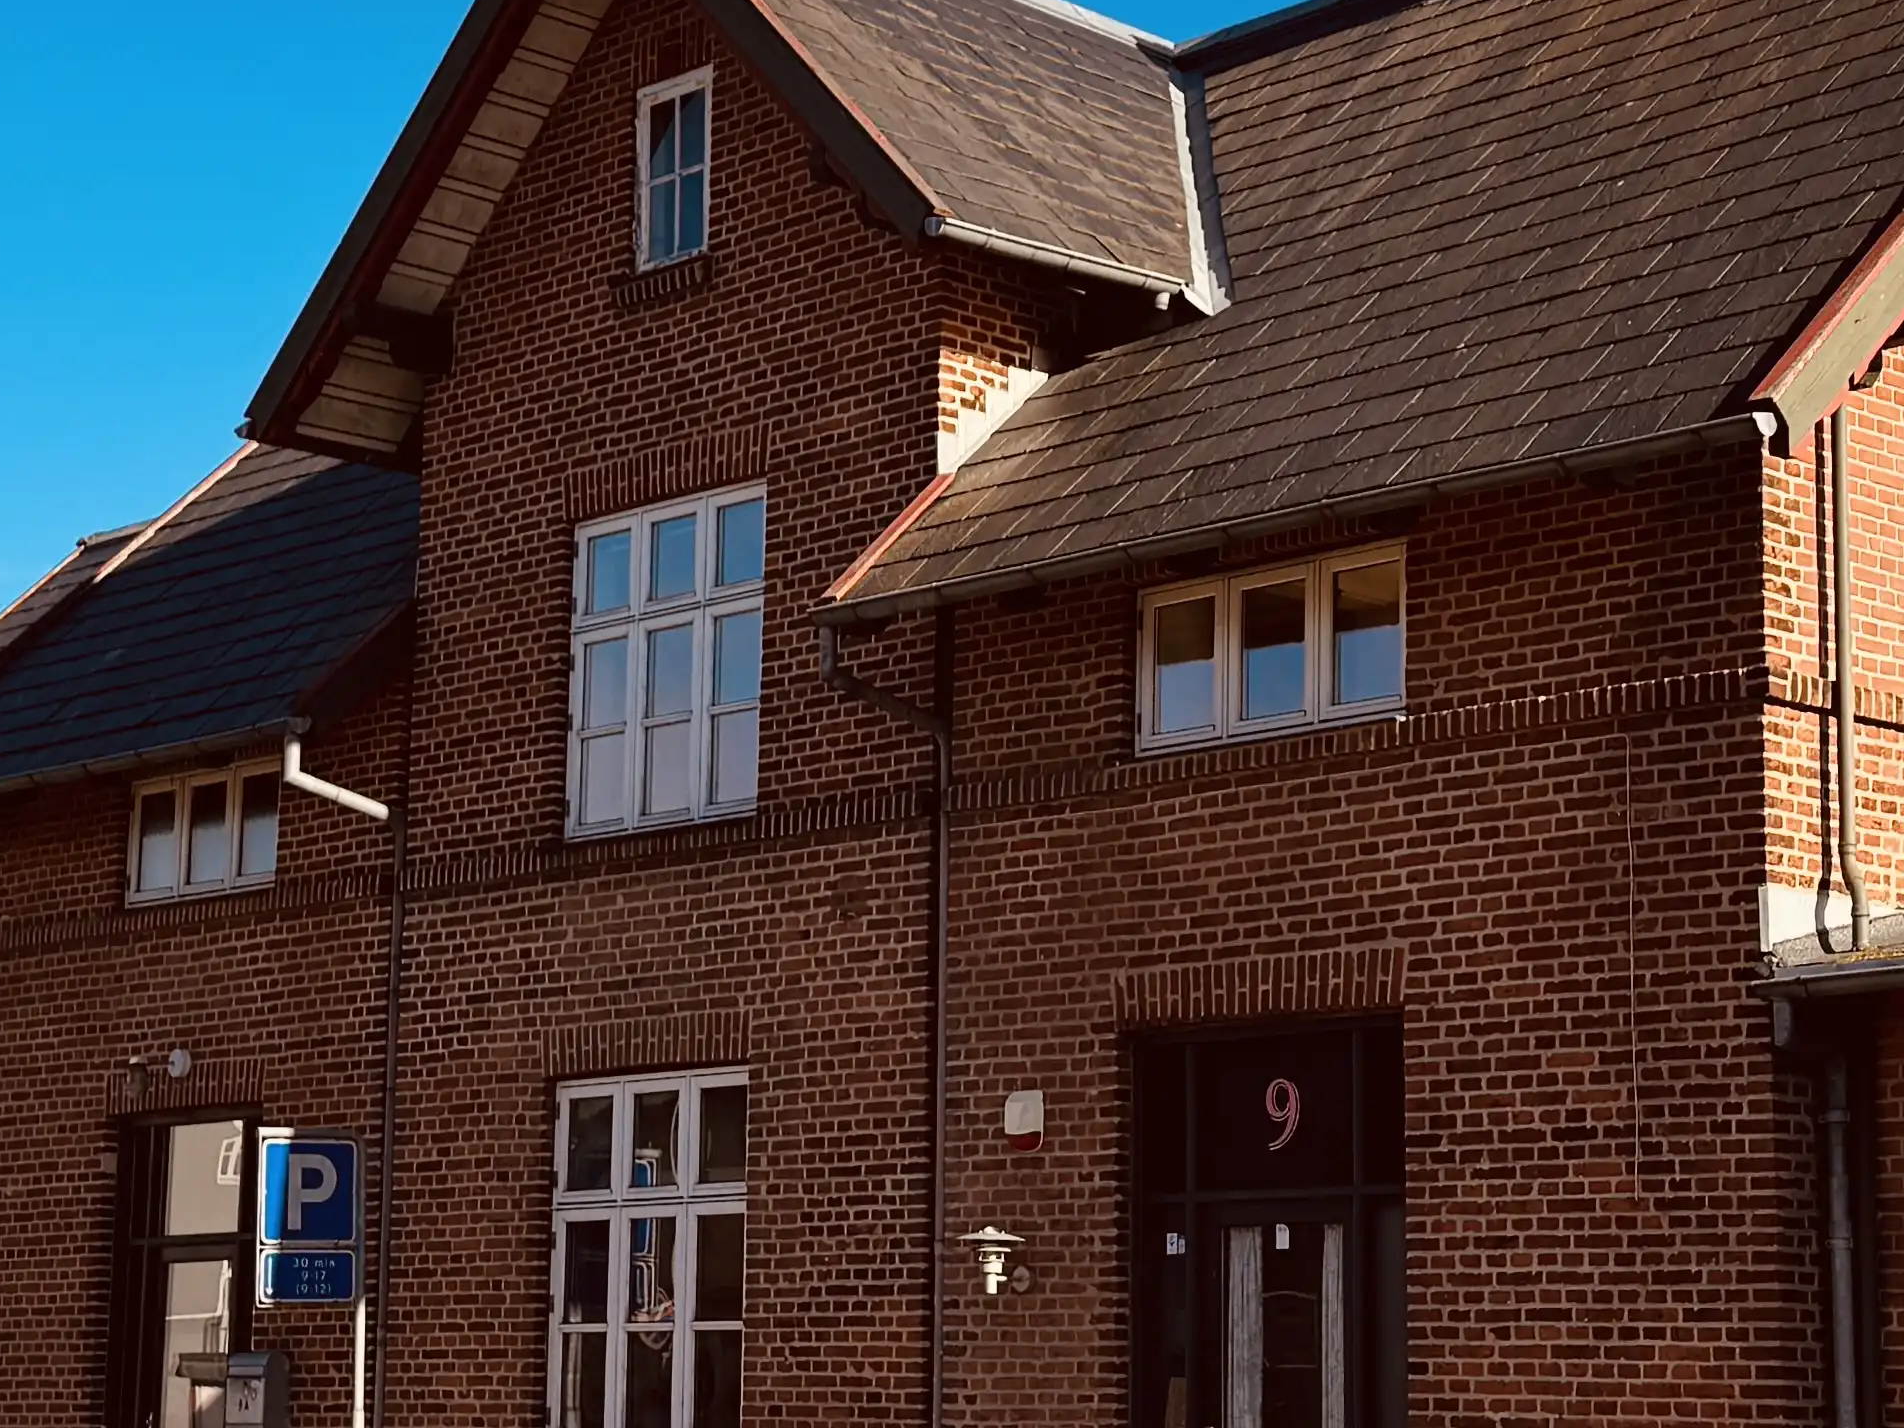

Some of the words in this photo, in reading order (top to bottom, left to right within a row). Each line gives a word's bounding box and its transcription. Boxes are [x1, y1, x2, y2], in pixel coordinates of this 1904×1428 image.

[1265, 1078, 1300, 1151] 9
[287, 1153, 337, 1230] P
[314, 1257, 335, 1268] min
[296, 1283, 332, 1295] (912)
